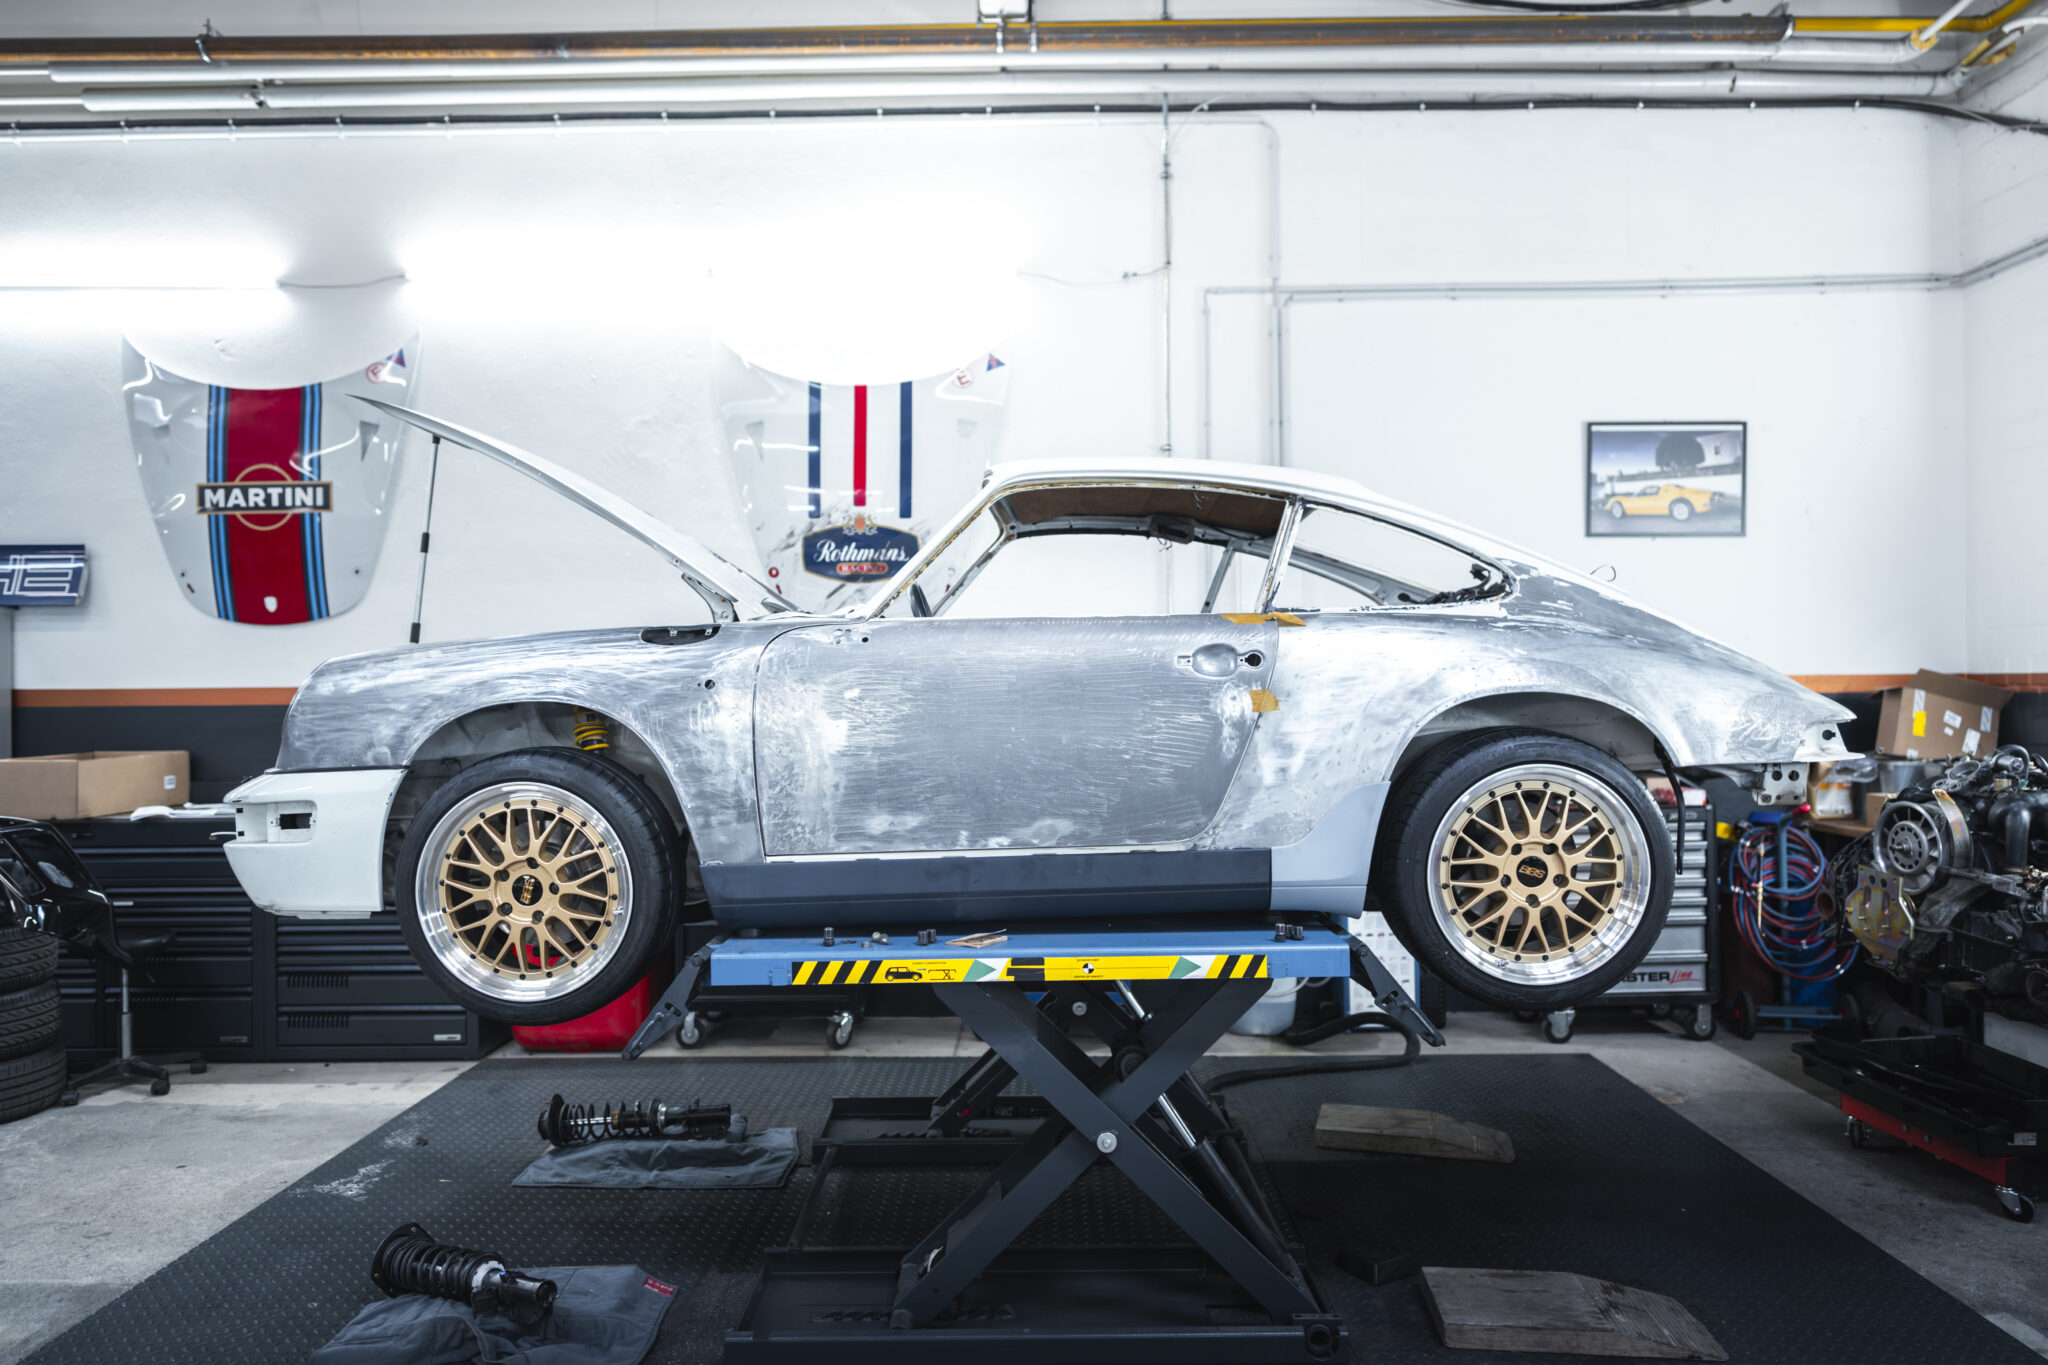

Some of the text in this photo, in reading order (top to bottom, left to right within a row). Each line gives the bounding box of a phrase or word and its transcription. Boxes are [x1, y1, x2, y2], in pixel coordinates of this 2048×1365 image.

[203, 486, 324, 509] MARTINI
[813, 538, 910, 563] Rothmans
[1518, 864, 1546, 879] BBS
